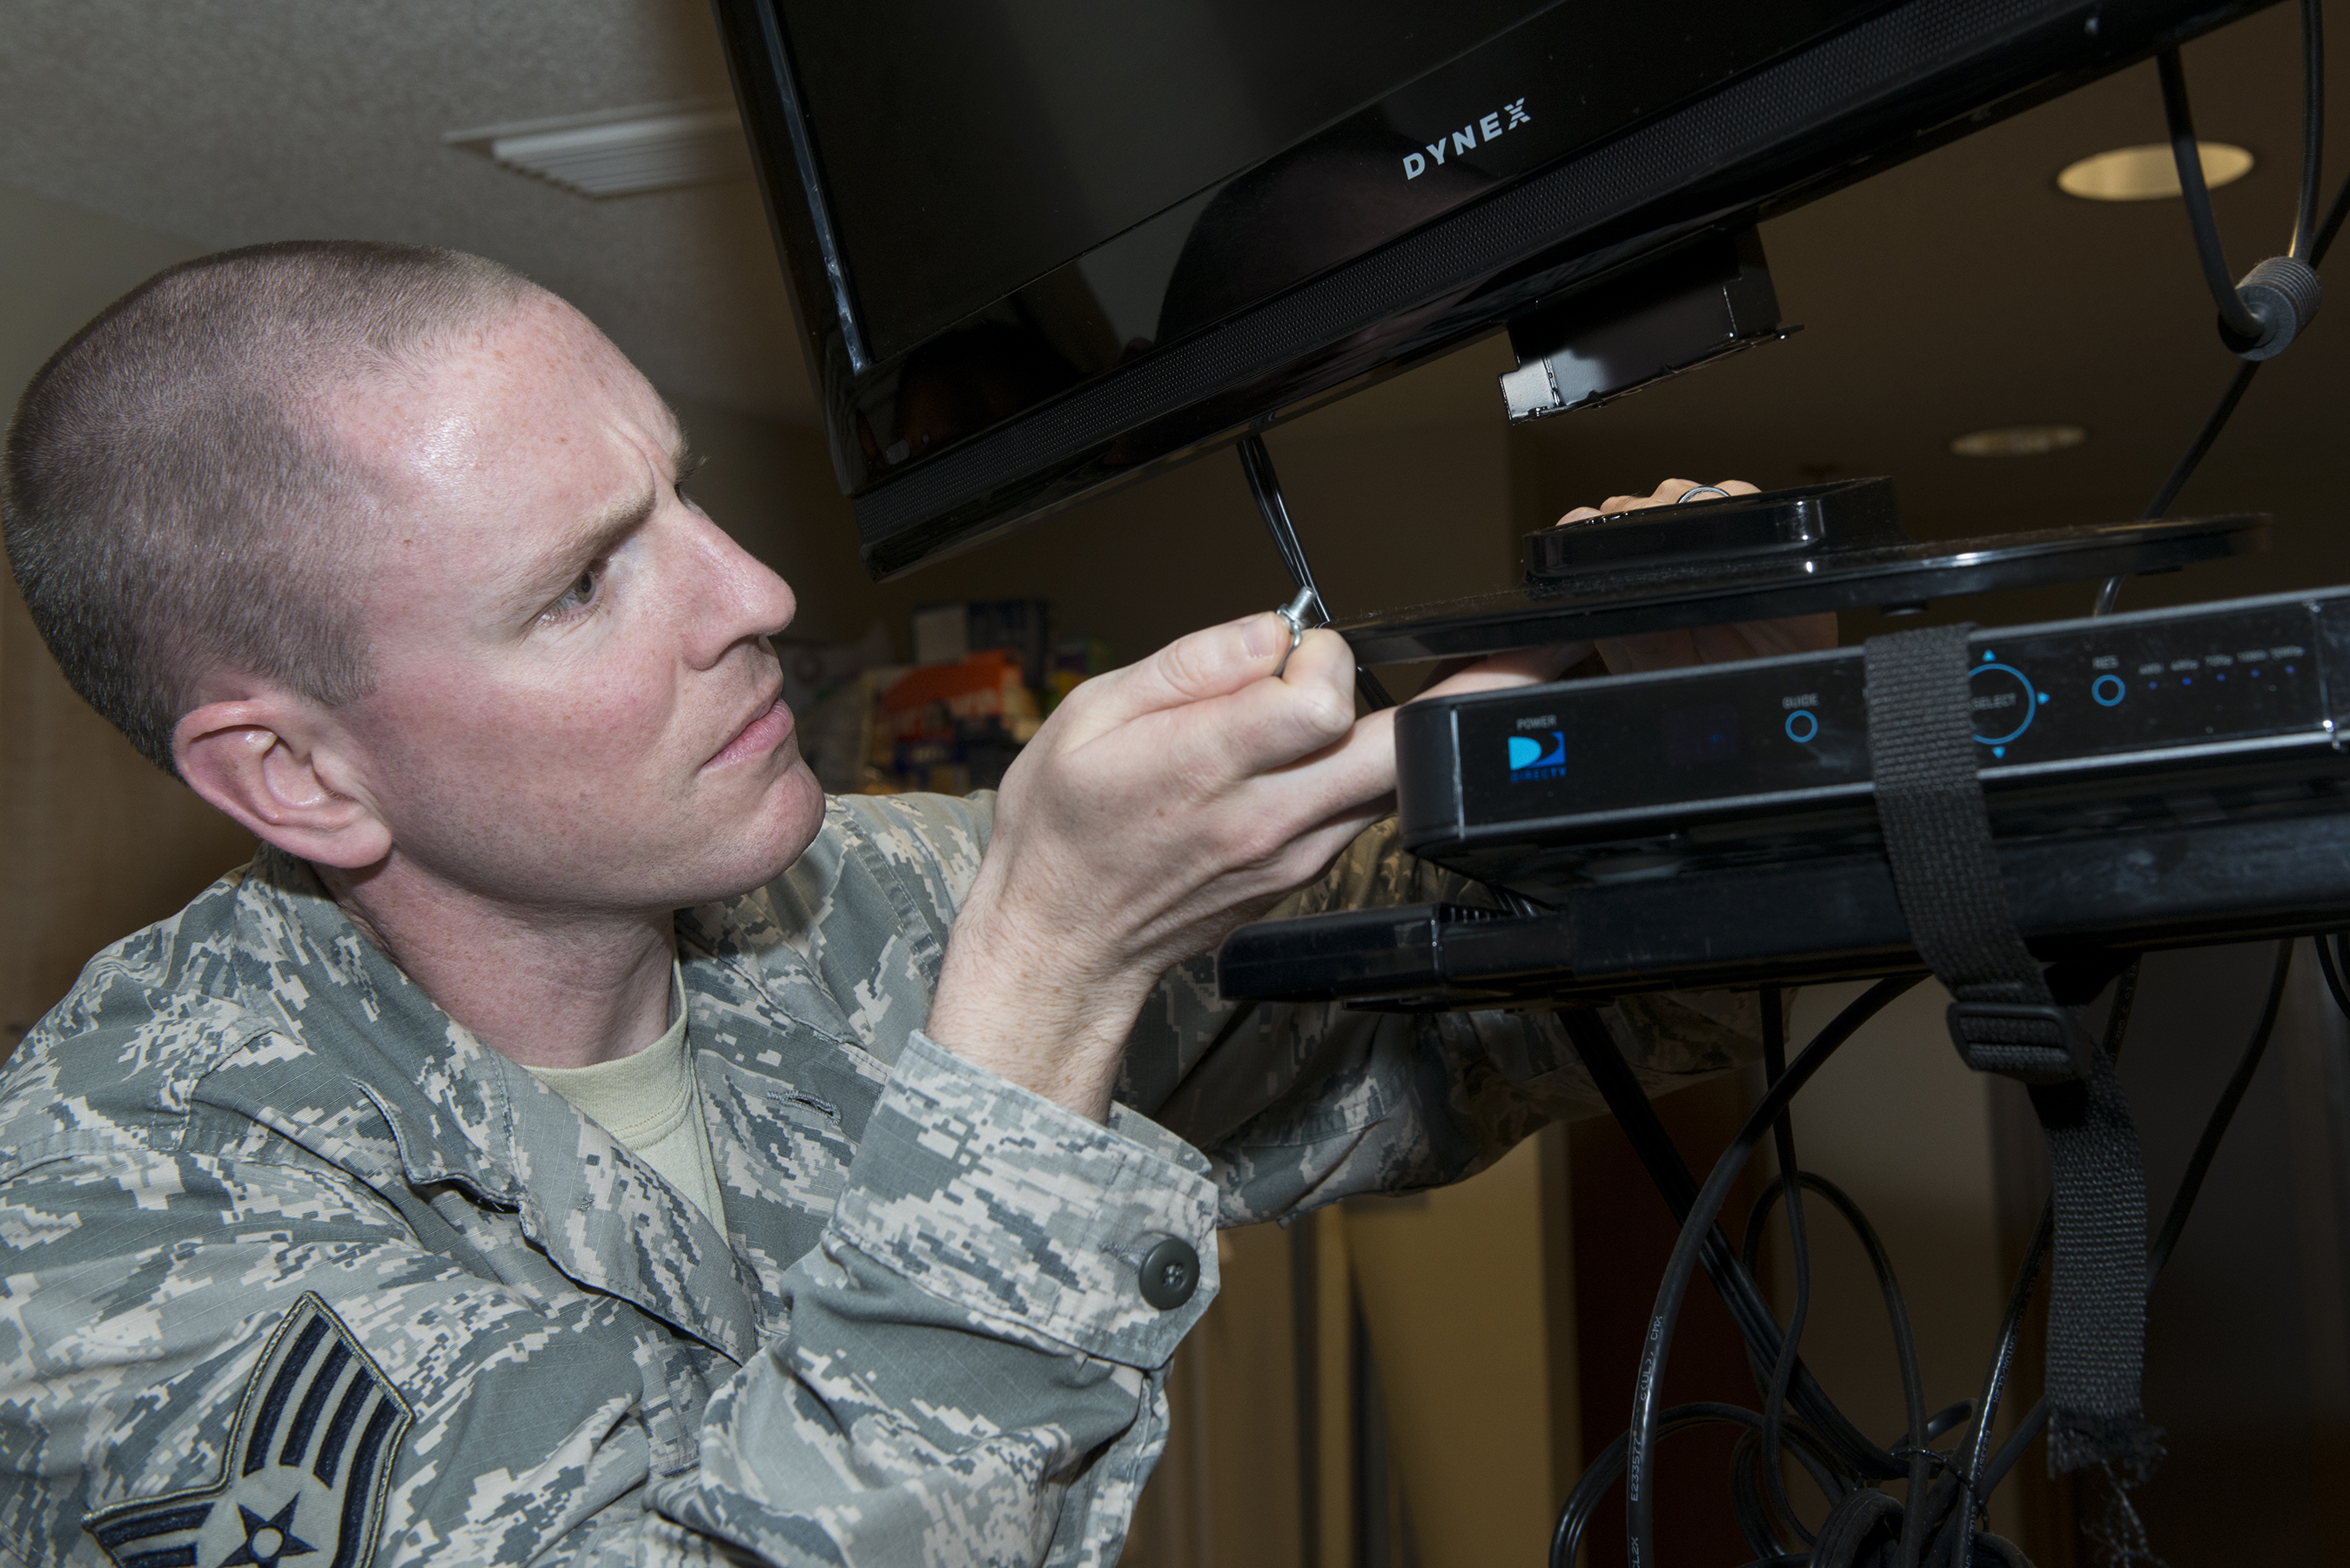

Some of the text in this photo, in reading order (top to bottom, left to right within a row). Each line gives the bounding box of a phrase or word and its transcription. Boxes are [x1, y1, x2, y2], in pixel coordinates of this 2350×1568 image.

[1402, 97, 1532, 181] DYNEX
[1516, 714, 1557, 731] POWER
[1782, 693, 1820, 710] GUIDE
[1630, 1437, 1641, 1503] E233577
[1649, 1315, 1663, 1342] CMX
